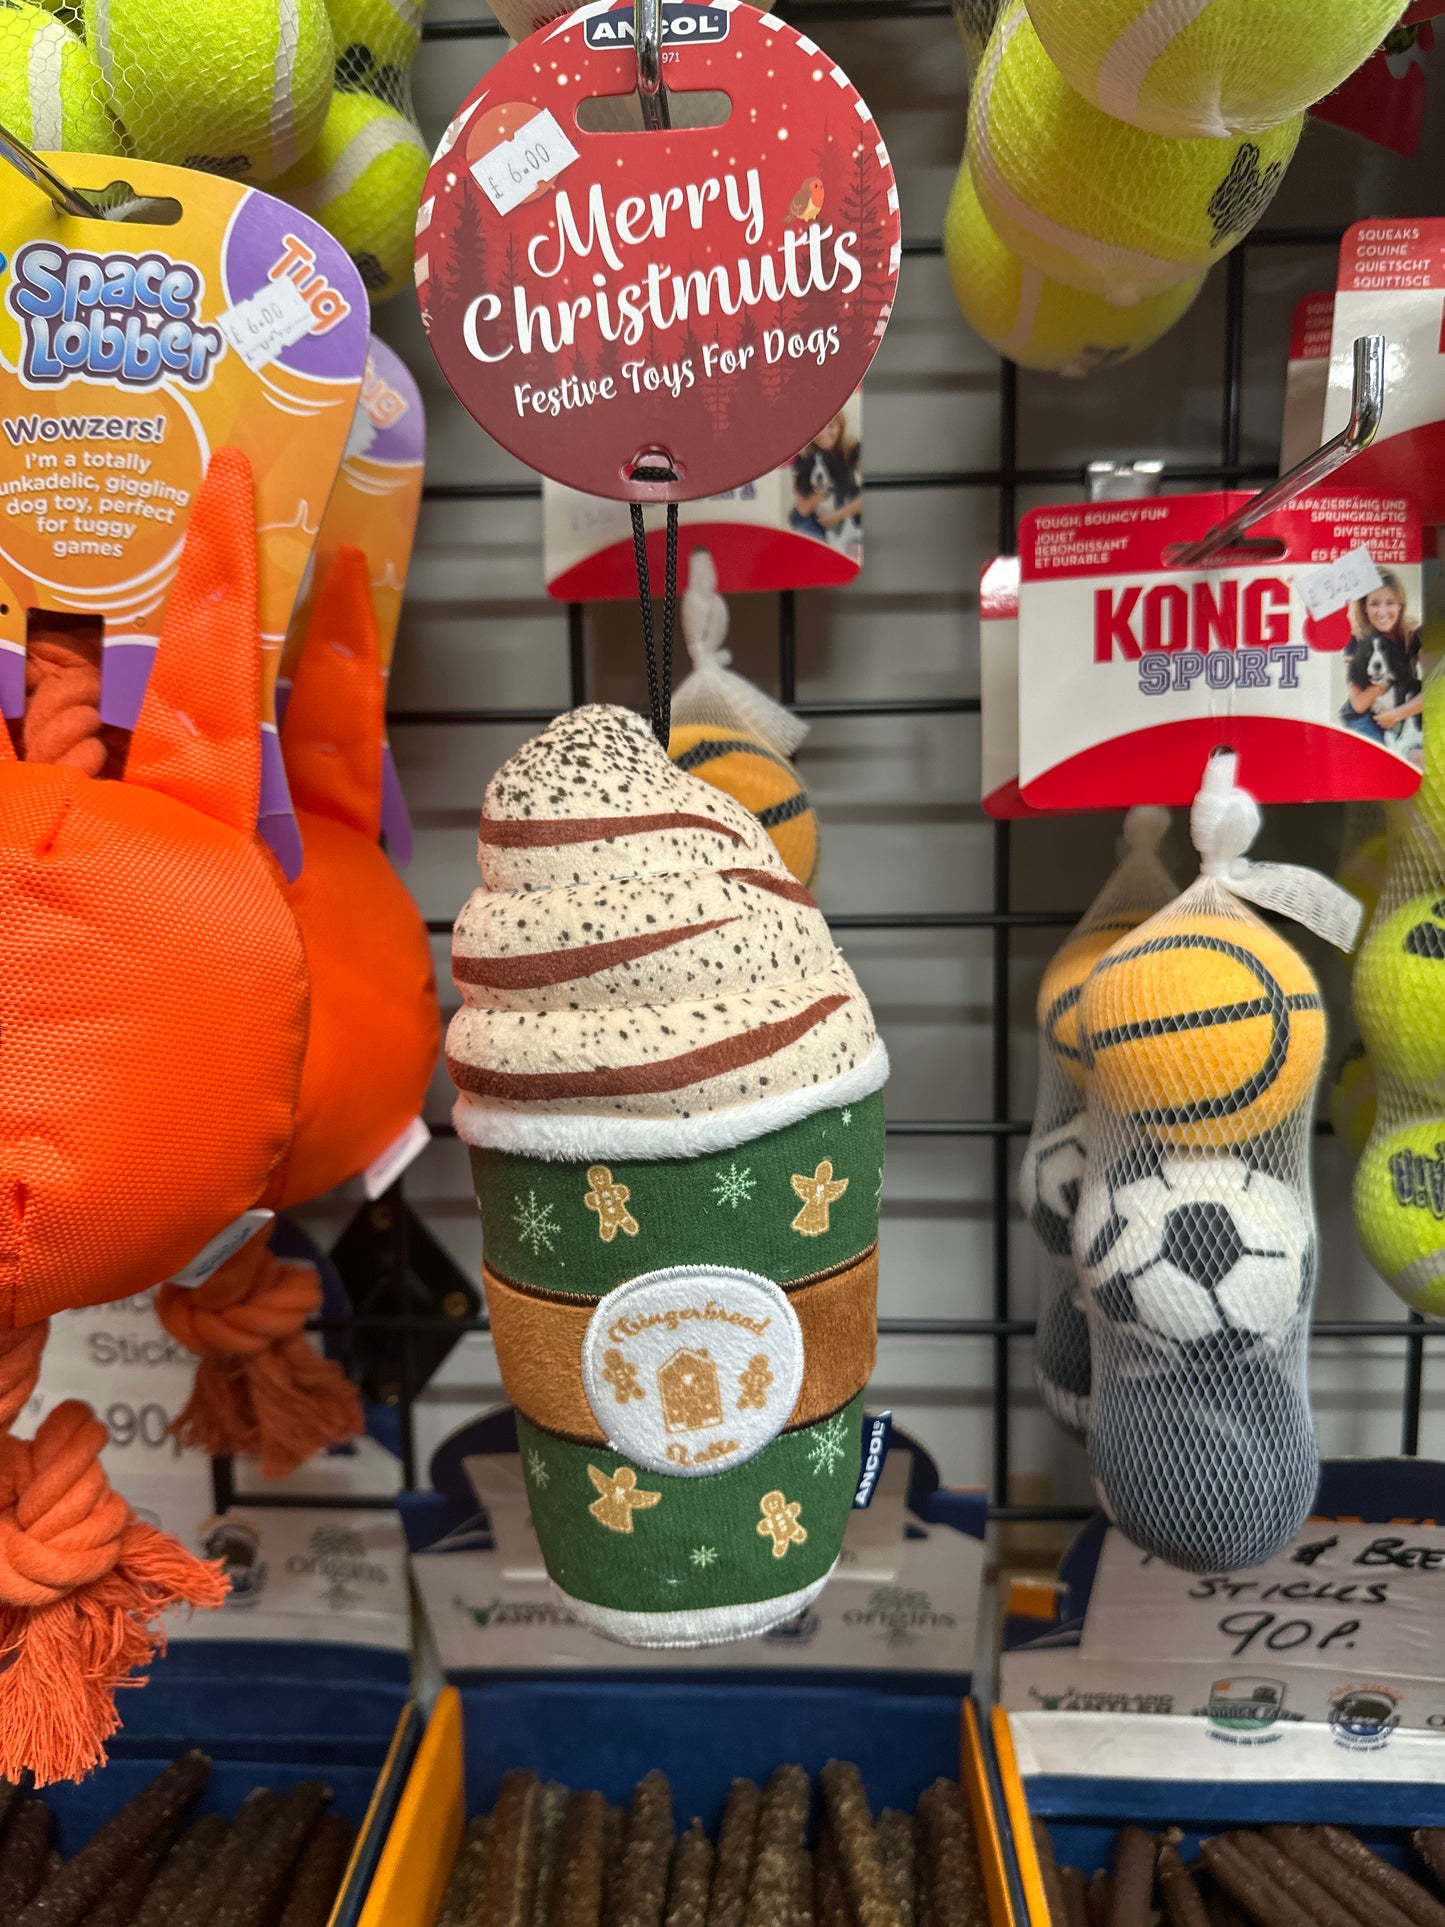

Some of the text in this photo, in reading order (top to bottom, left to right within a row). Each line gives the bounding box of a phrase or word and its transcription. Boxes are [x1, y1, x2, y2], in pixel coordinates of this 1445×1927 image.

[507, 142, 551, 185] 6.00
[527, 168, 765, 278] Merry
[1357, 228, 1420, 242] SQUEAKS
[1354, 259, 1431, 273] QUIETSCHT
[17, 248, 197, 322] Space
[268, 234, 351, 334] Tug
[462, 222, 862, 364] Christmutts
[1352, 275, 1431, 289] SQUITTISCE
[246, 302, 284, 336] 6.00
[30, 308, 220, 380] Lobber
[513, 323, 841, 417] Festive Toys For Dogs
[3, 414, 167, 446] Wowzers!
[64, 454, 76, 467] a
[83, 451, 152, 474] totally
[106, 476, 191, 507] giggling
[1383, 500, 1406, 510] UND
[6, 495, 176, 524] dog toy, perfect
[1035, 506, 1168, 530] TOUGH, BOUNCY FUN
[37, 517, 137, 539] for tuggy
[1035, 530, 1075, 545] JOUET
[1334, 526, 1406, 538] DIVERTENTE,
[53, 541, 124, 557] games
[1035, 537, 1129, 557] REBONDISSANT
[1035, 553, 1110, 568] ET DURABLE
[1311, 550, 1328, 561] ED
[1093, 577, 1291, 663] KONG
[1138, 647, 1308, 696] SPORT
[855, 1422, 885, 1505] ANCOL
